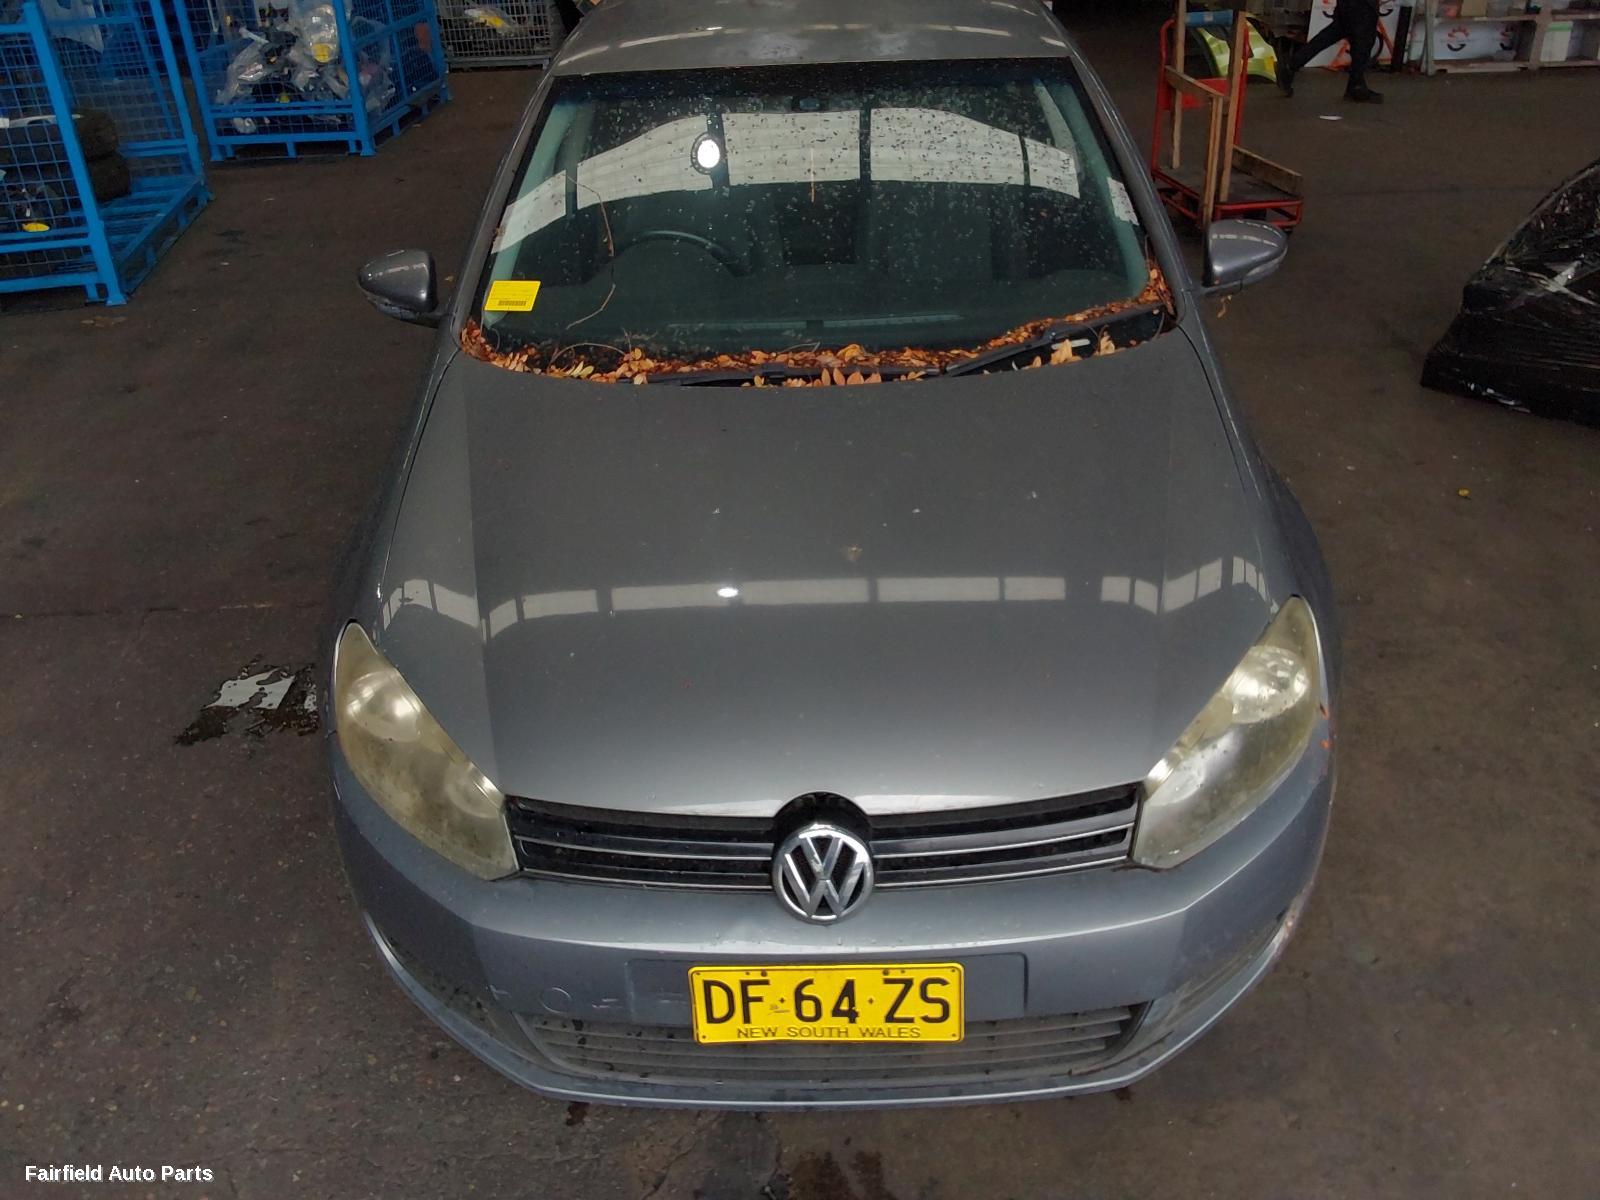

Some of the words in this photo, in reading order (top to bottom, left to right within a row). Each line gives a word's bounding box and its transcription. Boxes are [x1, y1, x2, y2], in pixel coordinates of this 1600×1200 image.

[702, 979, 771, 1024] DF
[794, 978, 859, 1024] 64
[883, 976, 950, 1024] ZS
[737, 1027, 779, 1039] NEW
[786, 1026, 849, 1039] SOUTH
[861, 1026, 921, 1038] WALES
